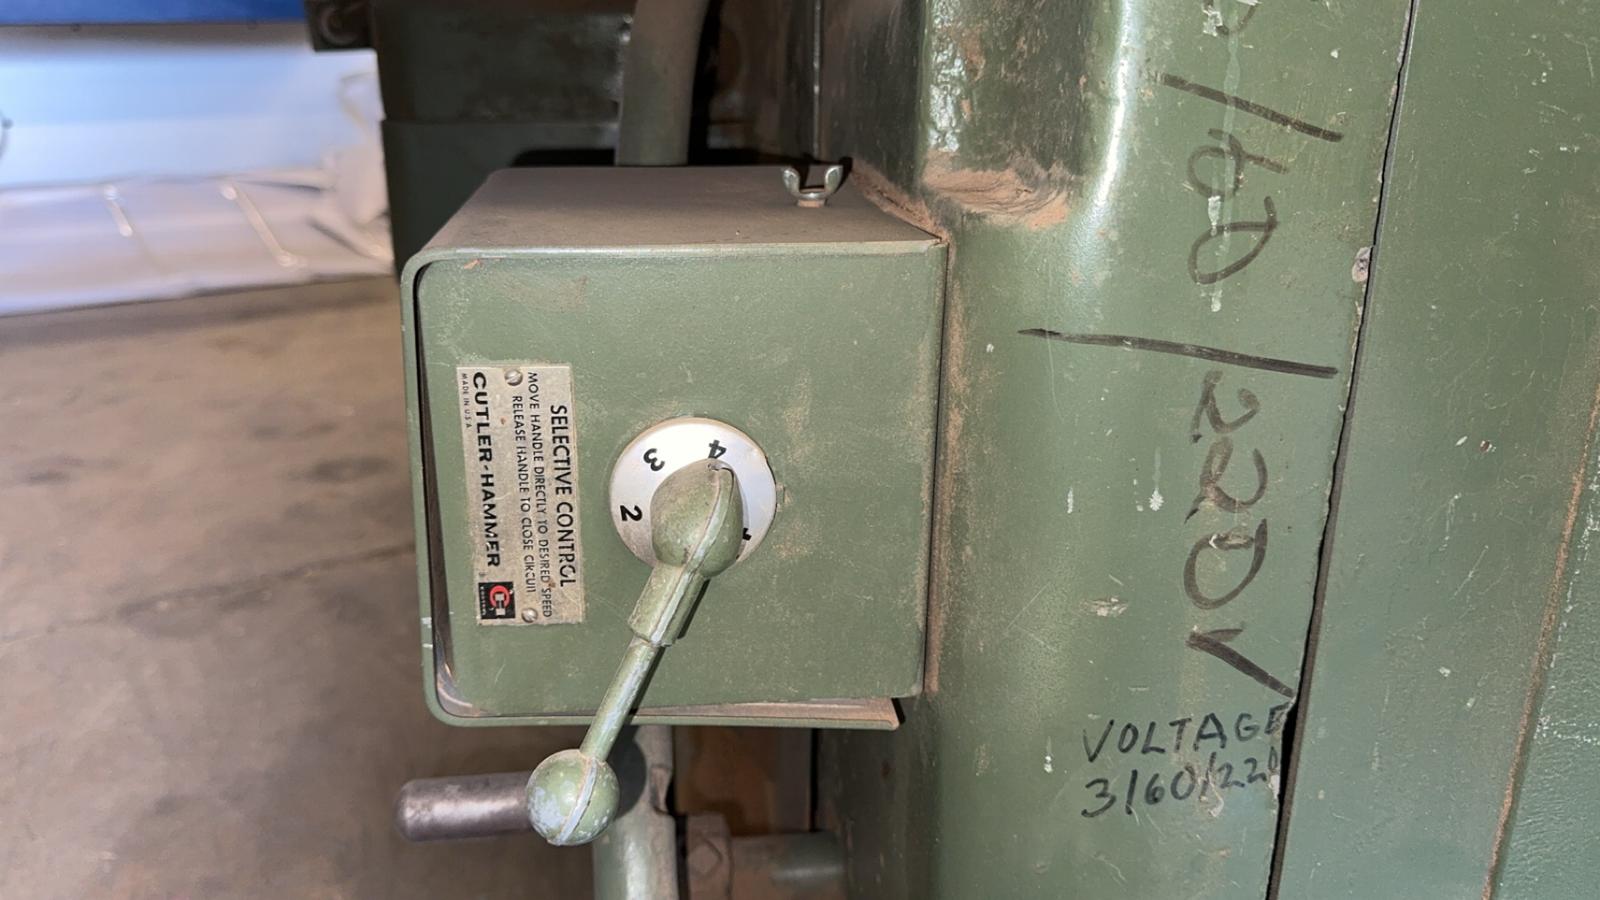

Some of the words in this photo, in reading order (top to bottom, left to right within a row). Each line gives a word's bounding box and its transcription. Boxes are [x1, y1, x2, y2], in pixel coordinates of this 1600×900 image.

[461, 373, 470, 395] MADE
[463, 397, 470, 406] IN
[527, 371, 540, 409] MOVE
[512, 395, 526, 441] RELEASE
[530, 414, 544, 462] HANDLE
[550, 404, 573, 495] SELECTIVE
[708, 440, 727, 460] 4
[473, 371, 501, 567] CUTLER-HAMMER
[516, 446, 530, 493] HANDLE
[643, 448, 666, 472] 3
[520, 497, 531, 513] TO
[533, 467, 547, 514] DIRECTLY
[537, 519, 548, 534] TO
[620, 505, 643, 522] 2
[521, 517, 534, 551] CLOSE
[556, 501, 577, 587] CONTROL
[538, 539, 551, 583] DESIRED
[541, 587, 552, 618] SPEED
